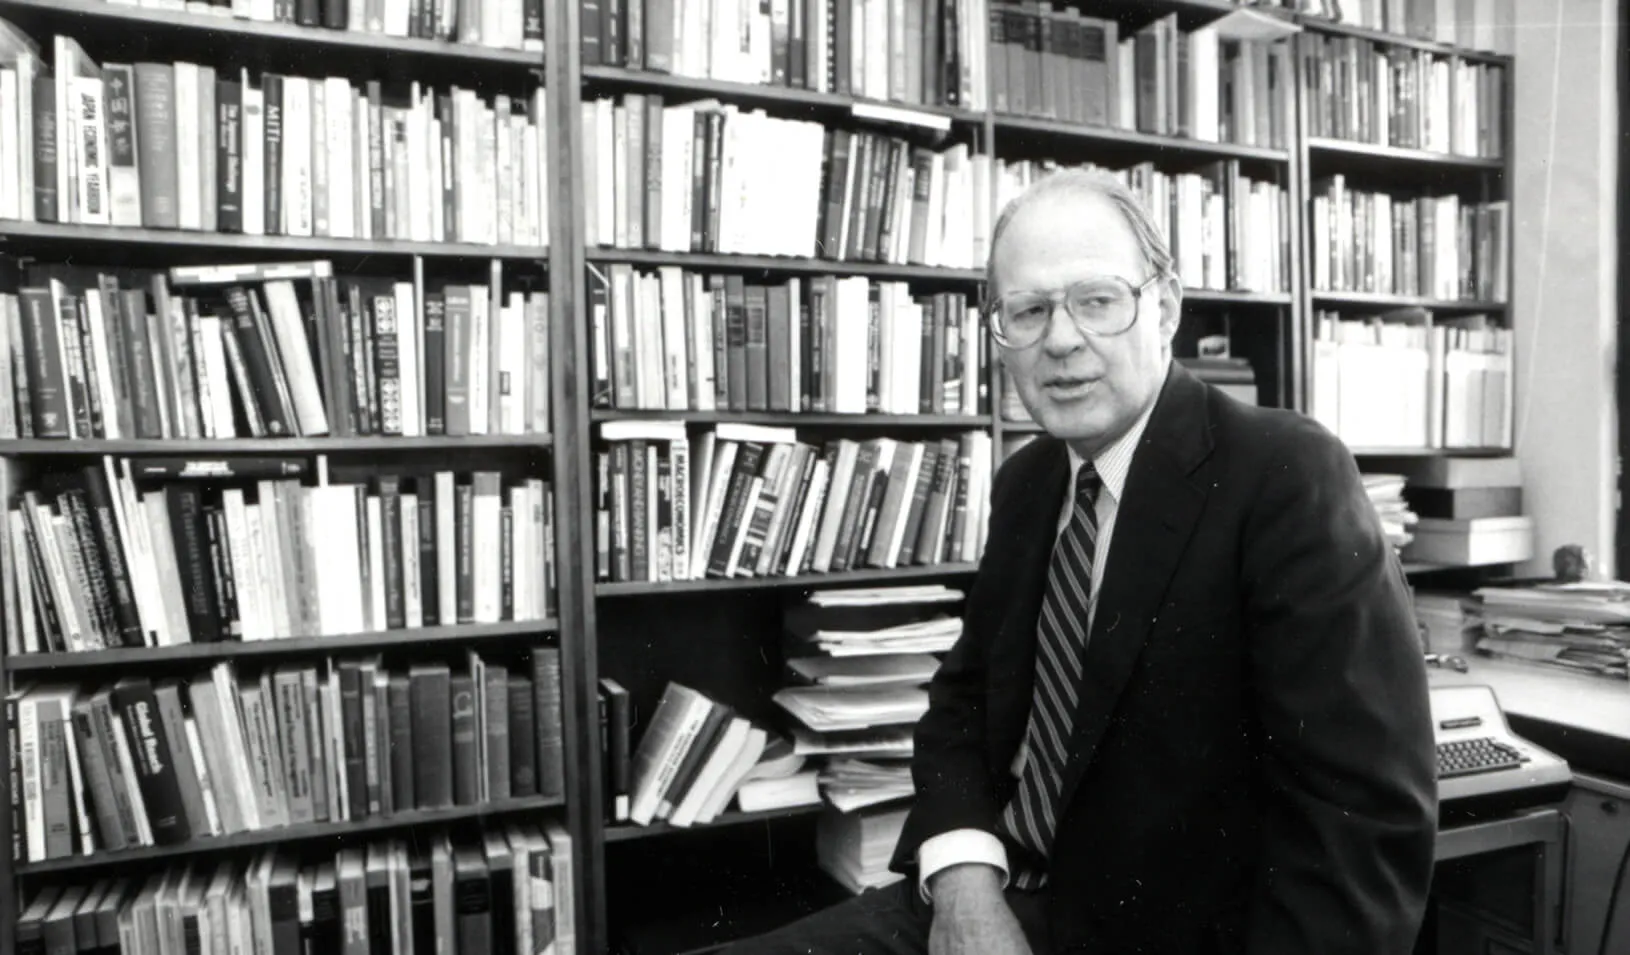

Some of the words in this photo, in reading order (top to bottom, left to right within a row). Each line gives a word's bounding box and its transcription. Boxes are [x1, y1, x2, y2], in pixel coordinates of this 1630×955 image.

[80, 92, 97, 120] JAPAN
[266, 104, 280, 143] MITI
[83, 124, 99, 168] ECONOMIC
[85, 173, 101, 214] YEARBOOK
[136, 701, 155, 737] Global
[145, 736, 165, 775] Reach
